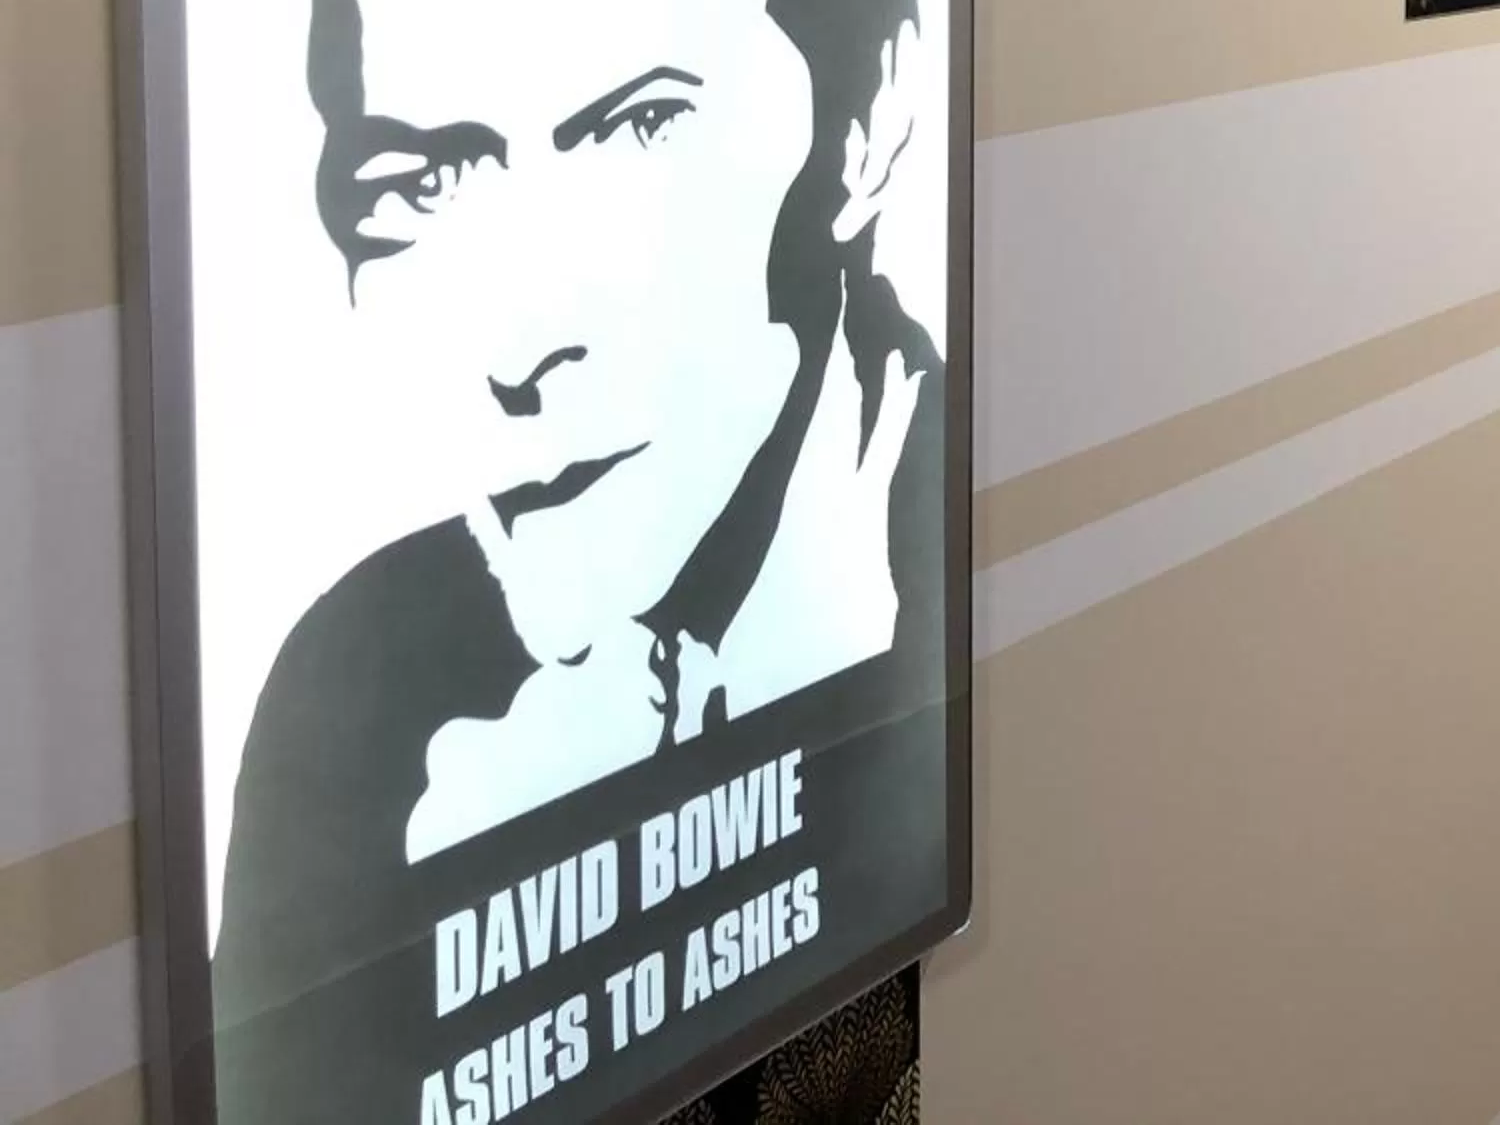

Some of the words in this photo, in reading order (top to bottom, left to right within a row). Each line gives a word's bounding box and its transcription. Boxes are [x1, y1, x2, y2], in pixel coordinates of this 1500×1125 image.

[419, 992, 589, 1125] ASHES
[605, 950, 665, 1052] TO
[682, 865, 820, 1013] ASHES
[435, 838, 618, 1018] DAVID
[640, 747, 803, 912] BOWIE
